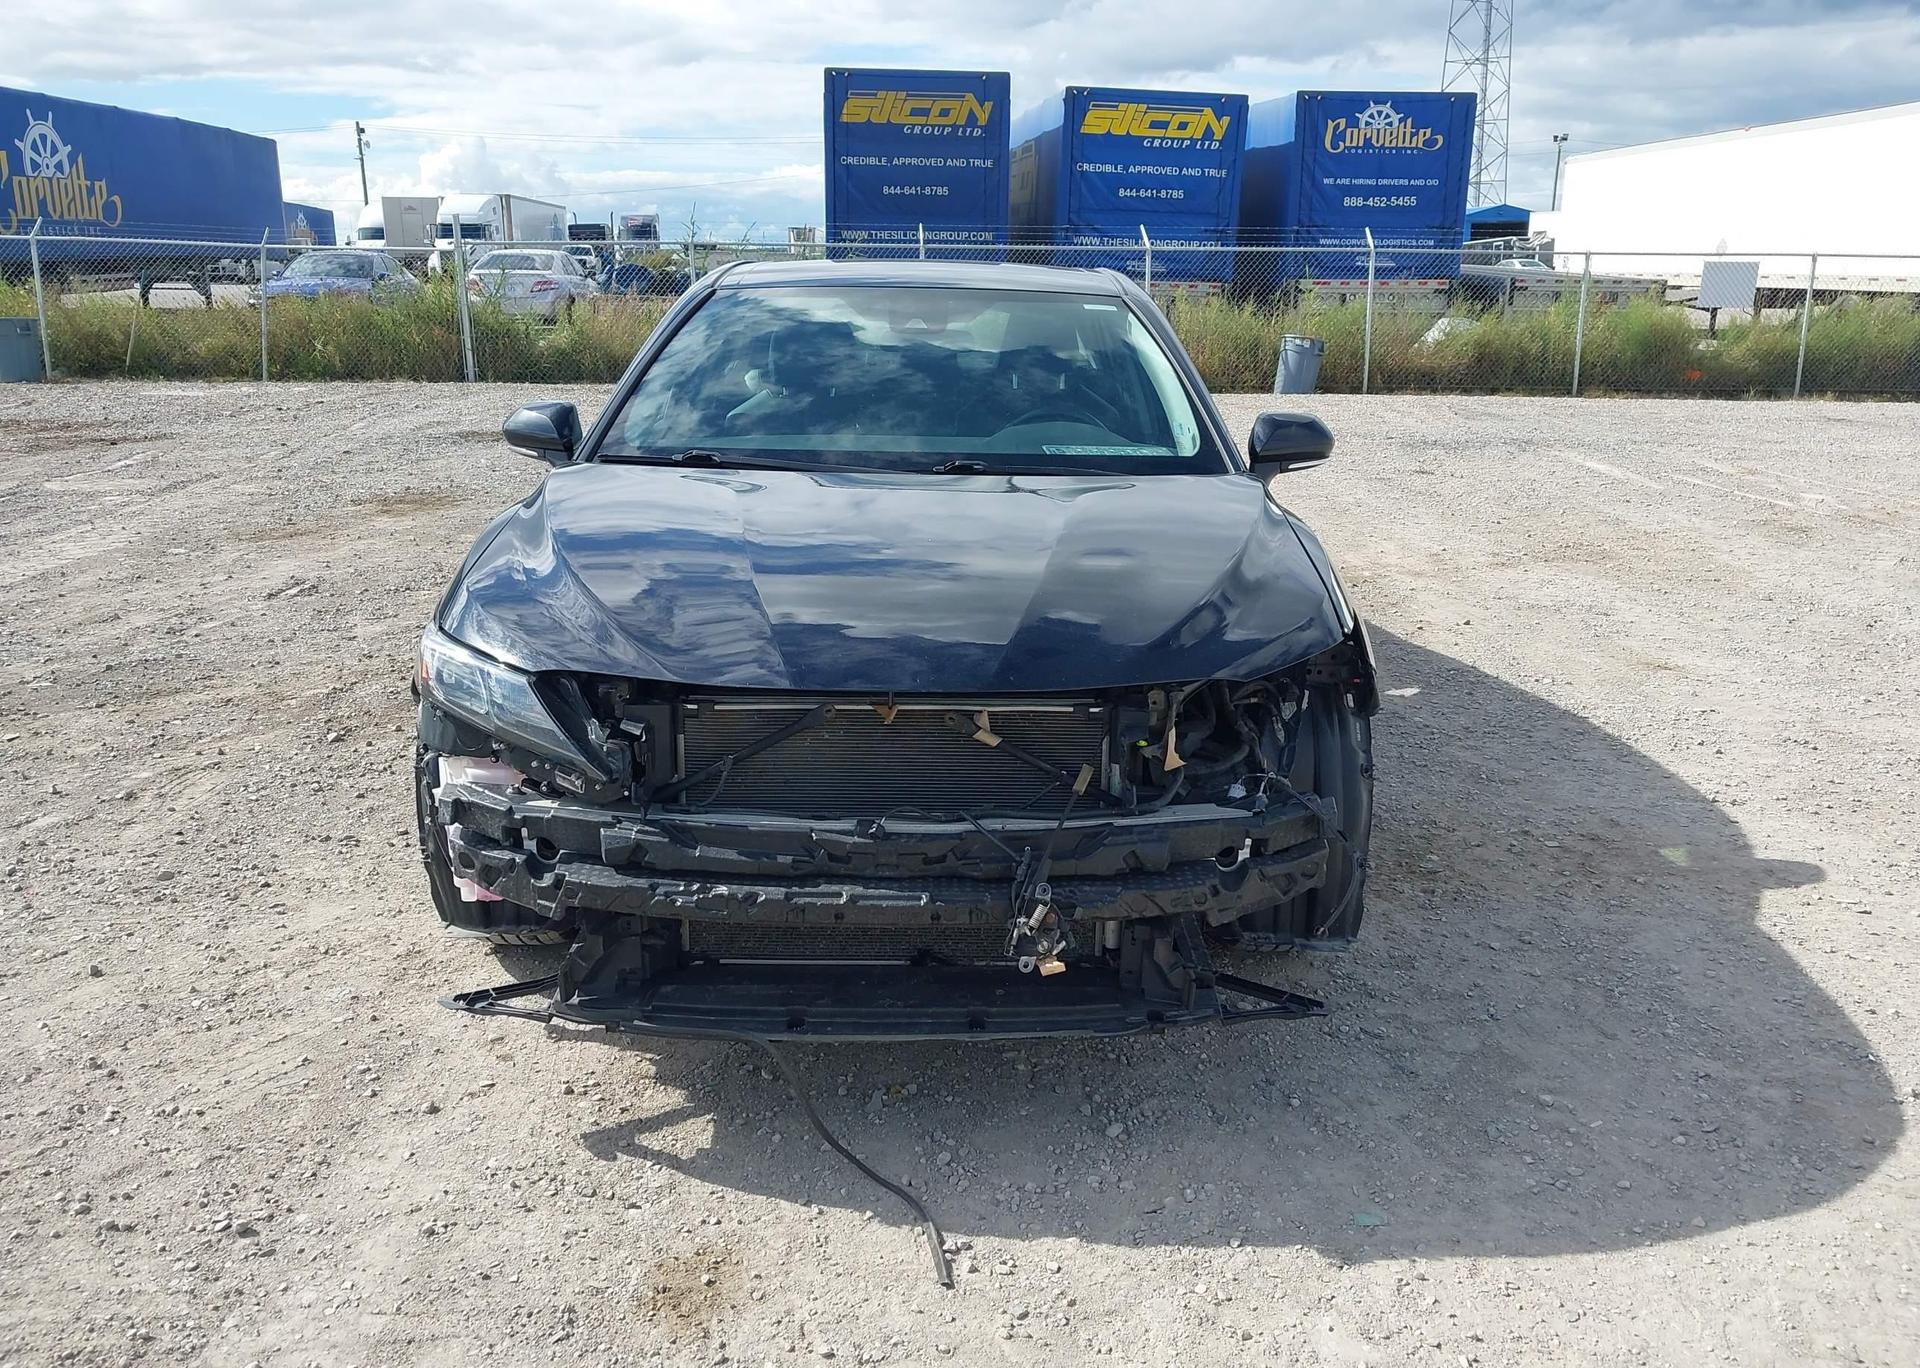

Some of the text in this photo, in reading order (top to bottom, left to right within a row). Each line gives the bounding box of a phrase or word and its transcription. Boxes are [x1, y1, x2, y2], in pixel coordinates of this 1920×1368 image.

[903, 125, 986, 137] GROUP LTD.
[1324, 117, 1444, 153] Corvette
[1143, 138, 1223, 150] GROUP LTD.
[840, 156, 994, 168] CREDIBLE, APPROVED AND TRUE
[1076, 162, 1228, 178] CREDIBLE, APPROVED AND TRUE
[1323, 177, 1335, 185] WE
[1352, 178, 1377, 186] HIRING
[1378, 178, 1409, 186] DRIVERS
[1409, 178, 1425, 186] AND
[1426, 178, 1439, 186] O/O
[882, 185, 949, 196] 844-641-8785
[1118, 187, 1184, 199] 844-641-8785
[1343, 196, 1417, 207] 888-452-5455
[20, 226, 79, 235] LOISTICS
[1319, 238, 1434, 246] WWW.CORVEELOGISTICS.COM
